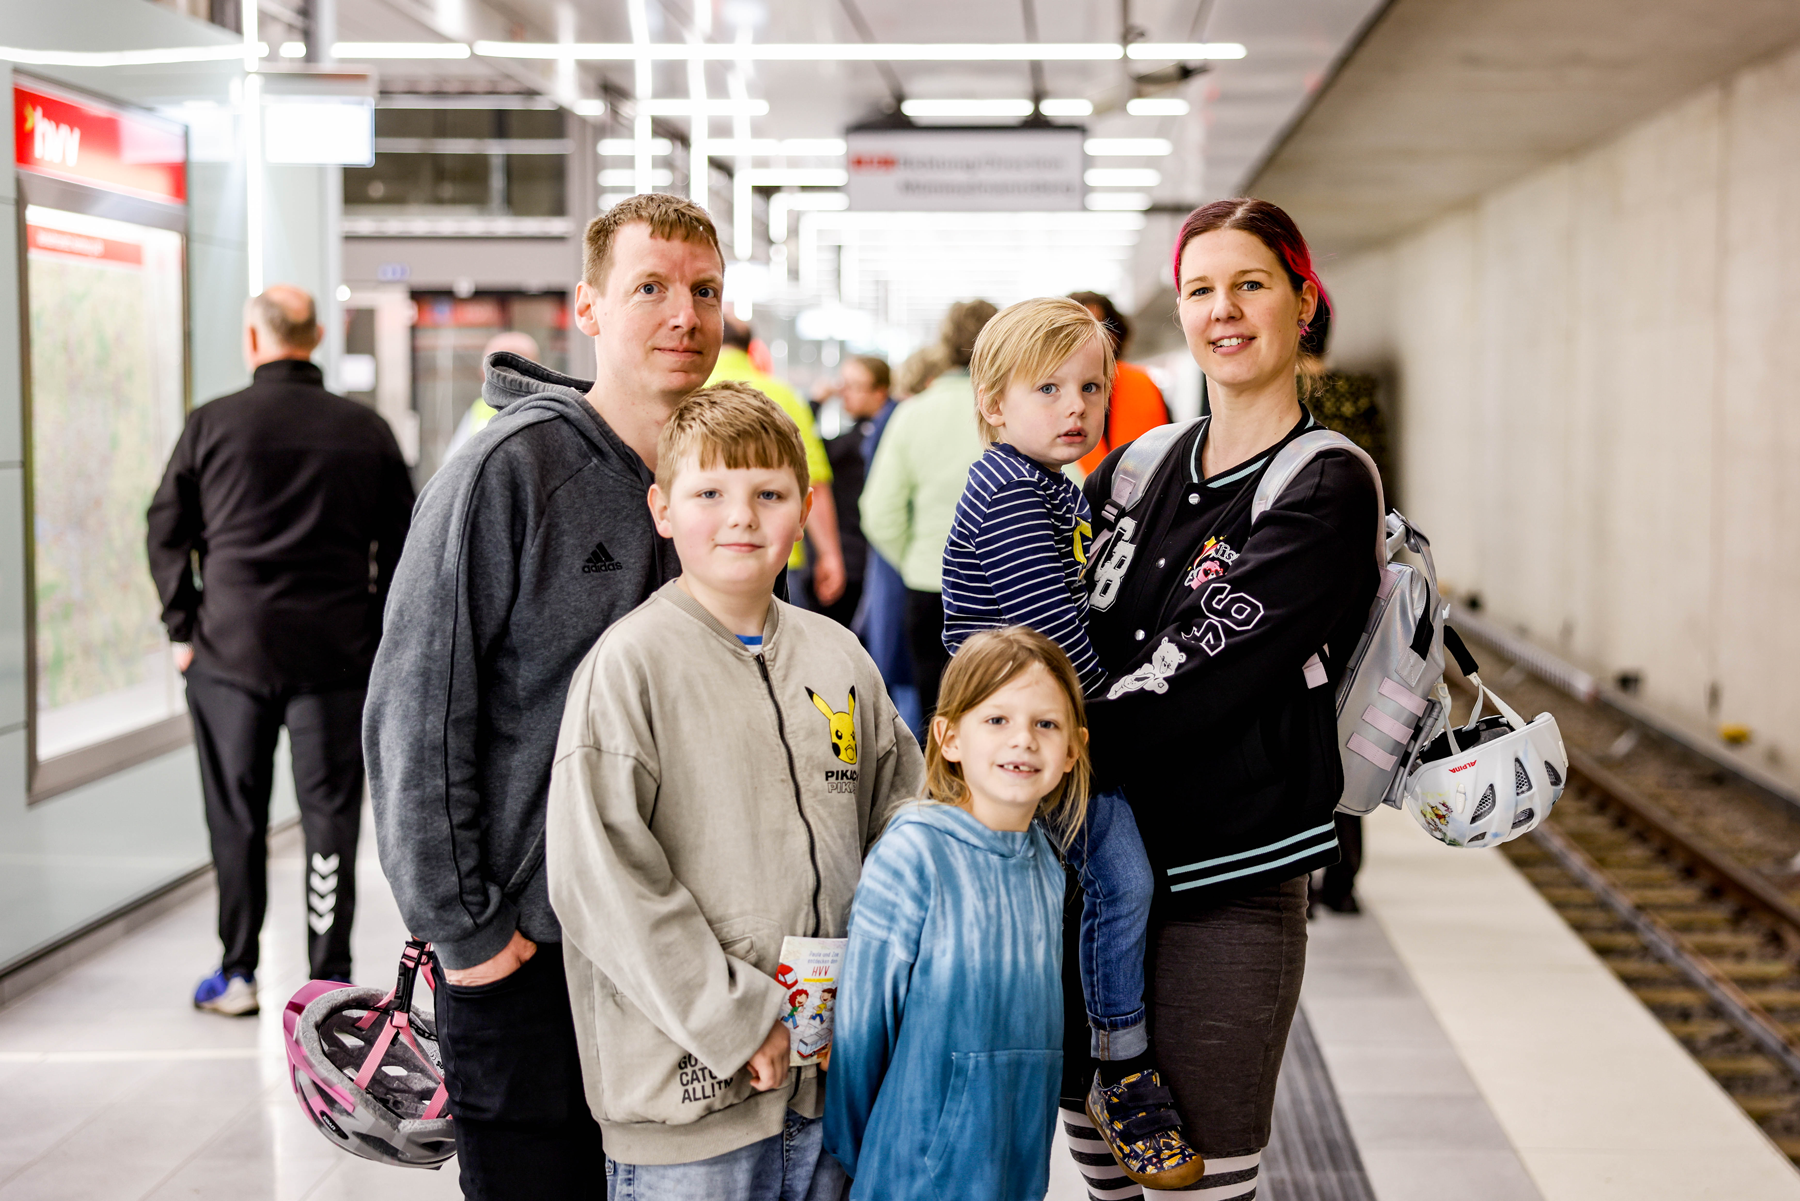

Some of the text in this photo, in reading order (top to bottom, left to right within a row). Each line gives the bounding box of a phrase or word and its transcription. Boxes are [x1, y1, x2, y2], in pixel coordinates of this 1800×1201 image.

[33, 105, 81, 167] hvv
[582, 561, 623, 574] adidas
[811, 965, 830, 977] HVV
[322, 1115, 337, 1131] uvex
